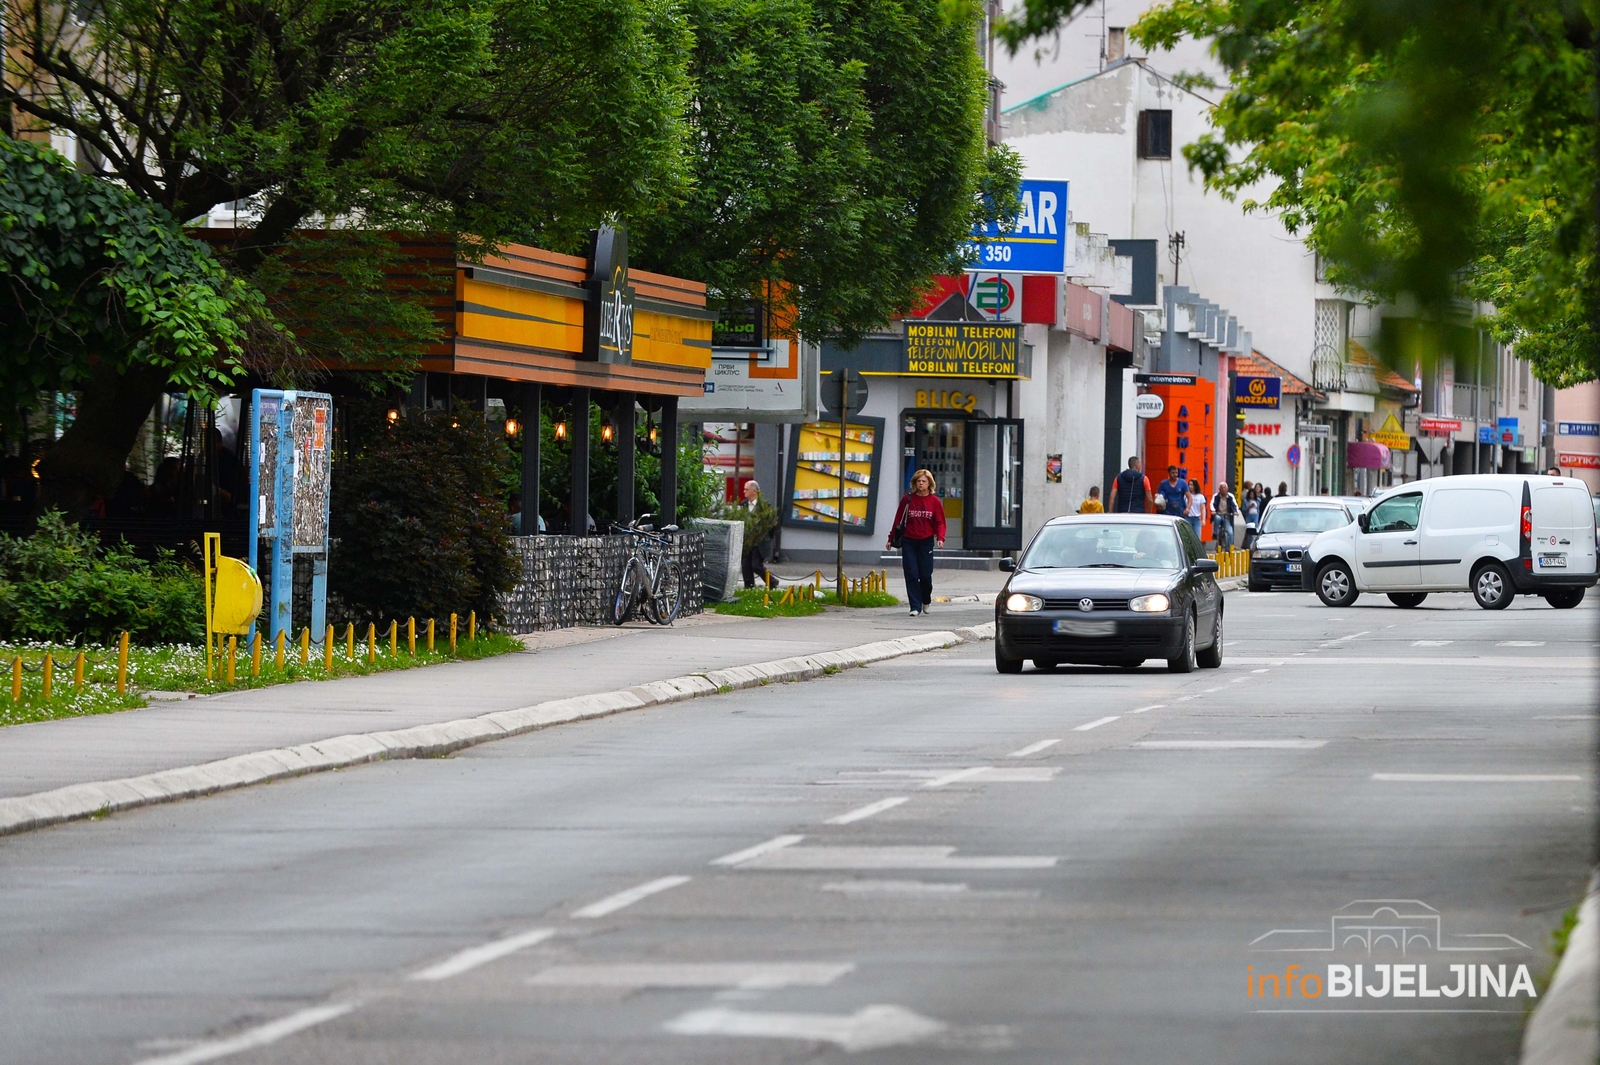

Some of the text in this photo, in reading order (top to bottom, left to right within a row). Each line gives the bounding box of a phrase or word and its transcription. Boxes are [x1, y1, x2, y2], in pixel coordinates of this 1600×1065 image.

[985, 245, 1012, 262] 350
[908, 326, 1016, 339] MOBILNI TELEFONI
[908, 338, 955, 347] TELEFONI
[907, 340, 1015, 361] TELEFONI MOBILNI
[909, 361, 1015, 374] MOBILNI TELEFONI
[1235, 396, 1279, 405] MOZZART
[1560, 455, 1600, 465] OPTIKA
